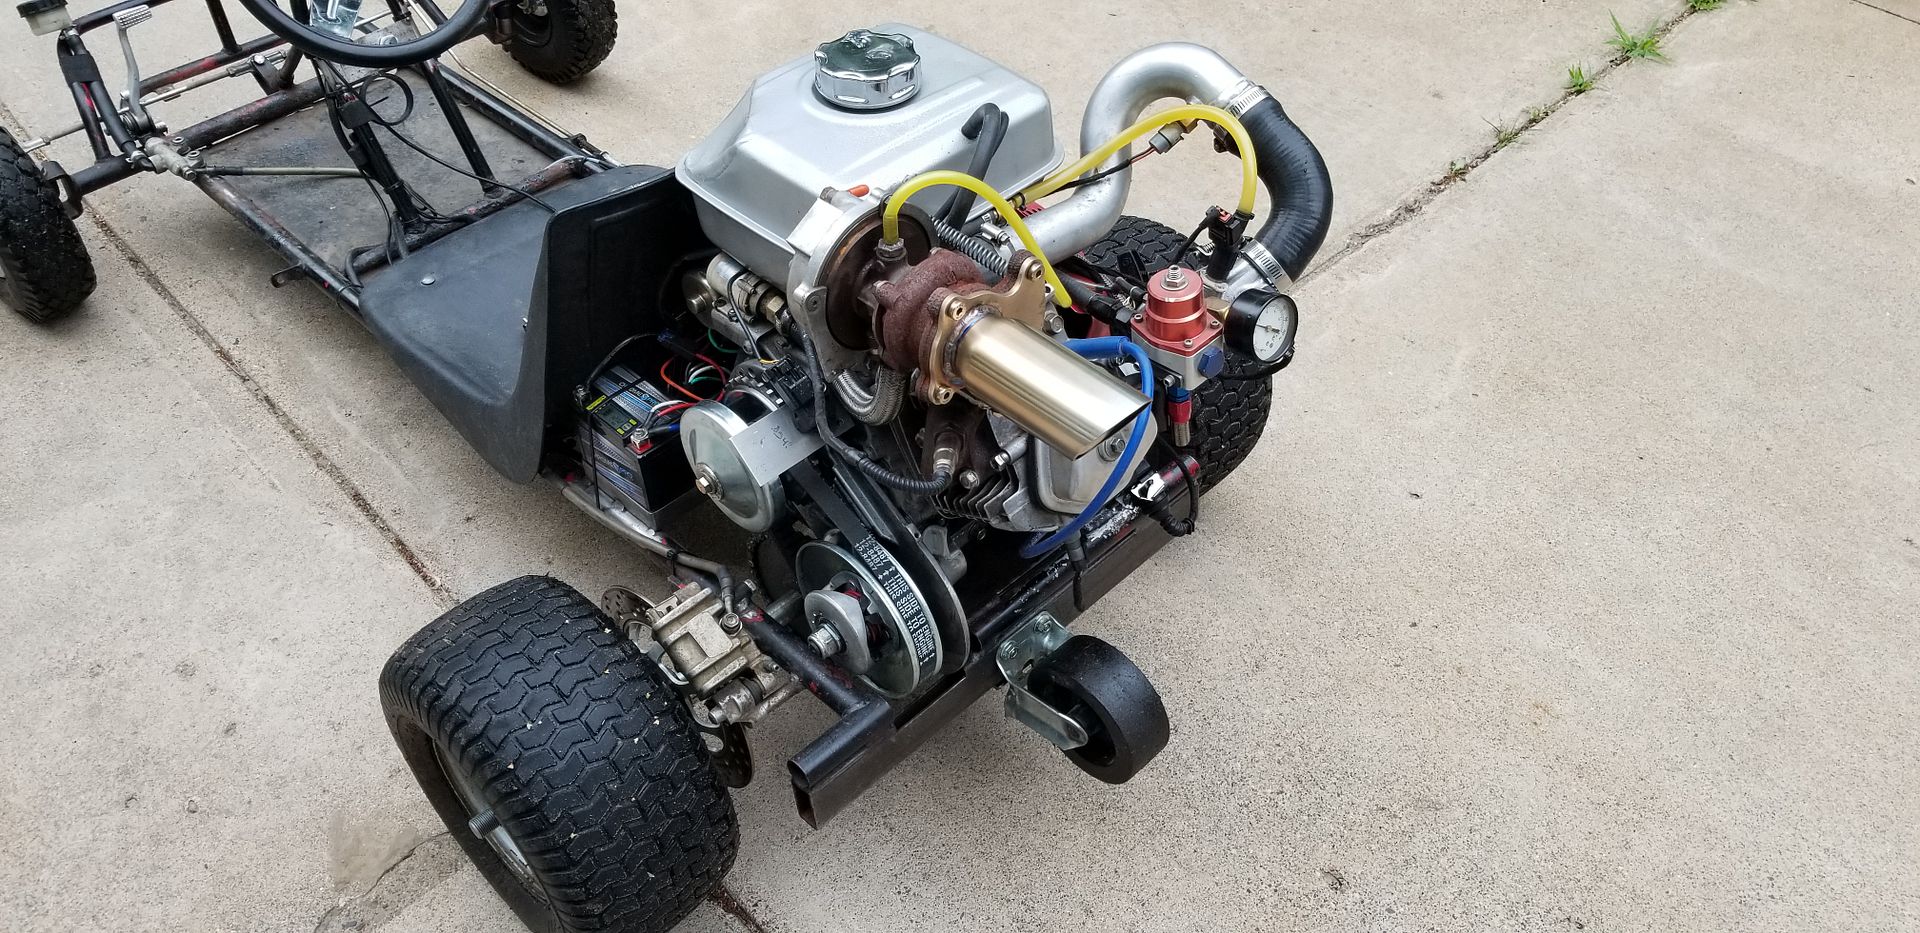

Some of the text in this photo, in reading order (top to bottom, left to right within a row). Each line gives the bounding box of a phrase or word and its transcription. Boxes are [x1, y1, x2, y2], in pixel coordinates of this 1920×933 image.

[860, 538, 929, 657] 12-8487 THIS SIDE TO ENGINE
[894, 573, 910, 591] THIS
[907, 592, 921, 612] SIDE
[917, 611, 926, 625] TO
[922, 624, 935, 652] ENGINE
